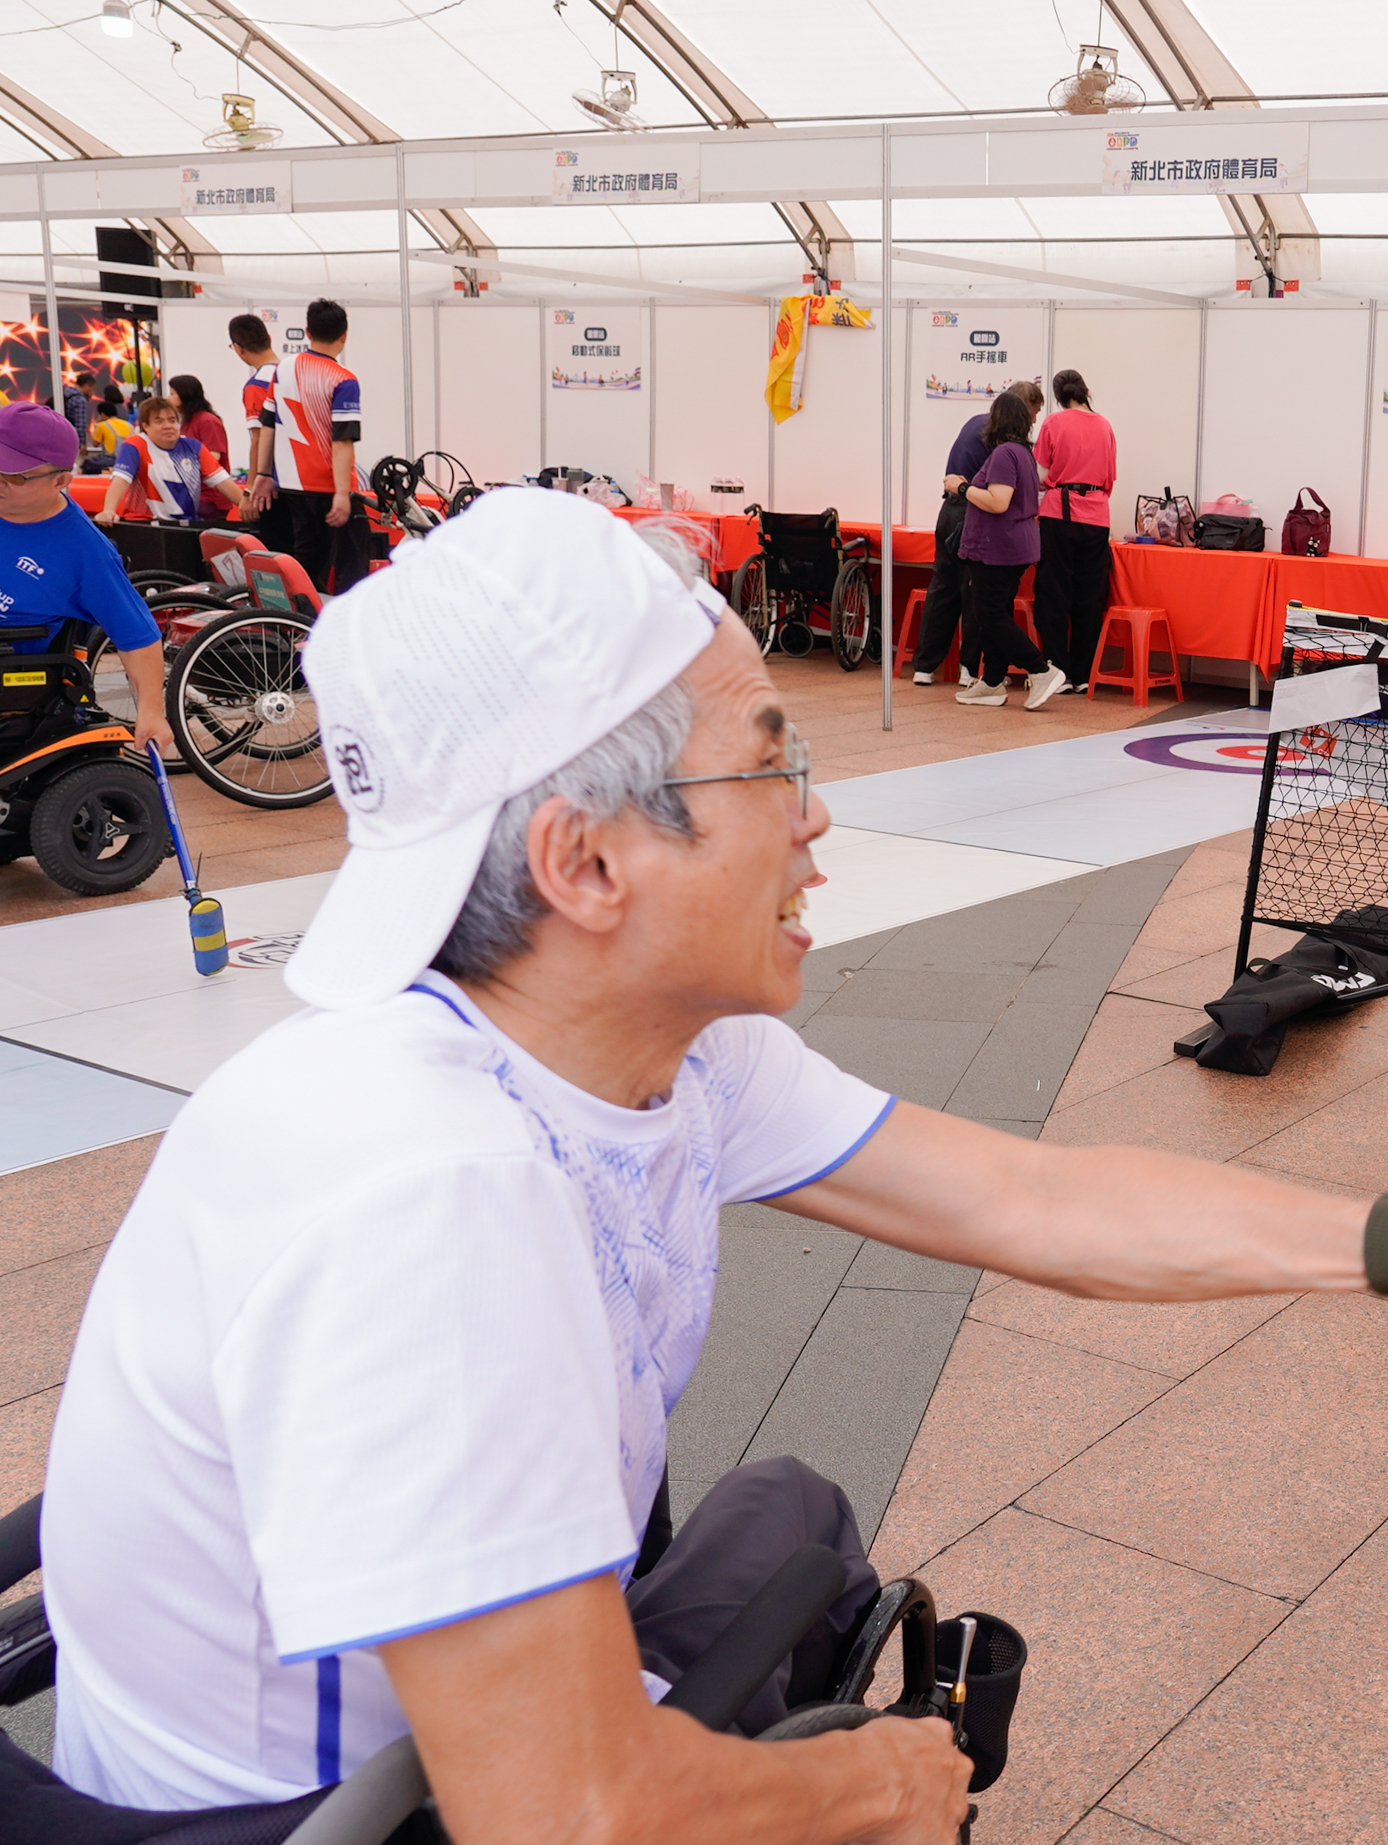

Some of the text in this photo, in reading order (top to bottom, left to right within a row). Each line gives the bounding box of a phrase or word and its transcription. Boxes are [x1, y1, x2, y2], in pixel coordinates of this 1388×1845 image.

[1131, 158, 1278, 181] 新北市政府體育局
[572, 173, 678, 192] 新北市政府體育局
[196, 187, 275, 205] 新北市政府體育局
[16, 558, 37, 573] ITF
[0, 589, 14, 606] up
